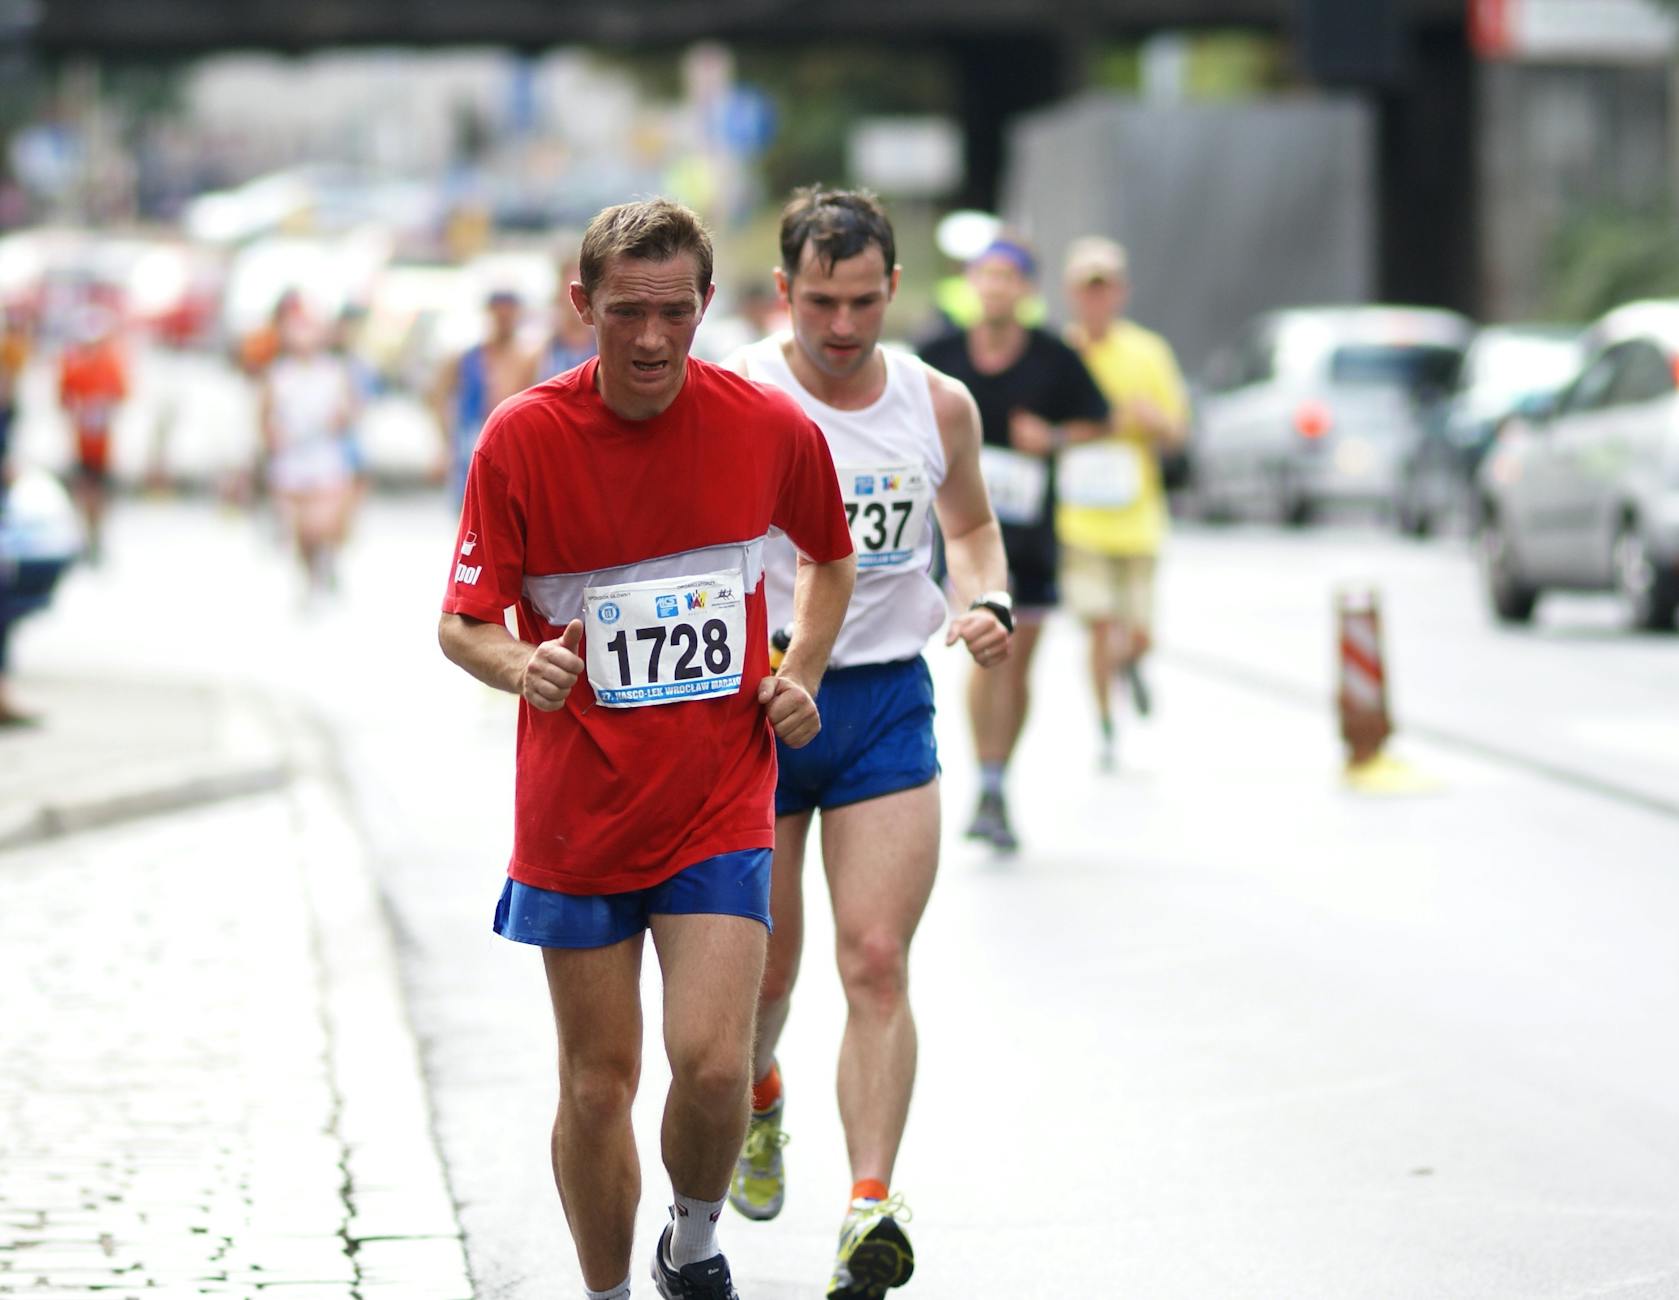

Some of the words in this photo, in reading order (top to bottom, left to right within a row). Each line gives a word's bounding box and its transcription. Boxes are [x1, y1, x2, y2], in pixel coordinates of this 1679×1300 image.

[845, 501, 913, 550] 737
[454, 558, 483, 585] pol
[607, 618, 731, 686] 1728
